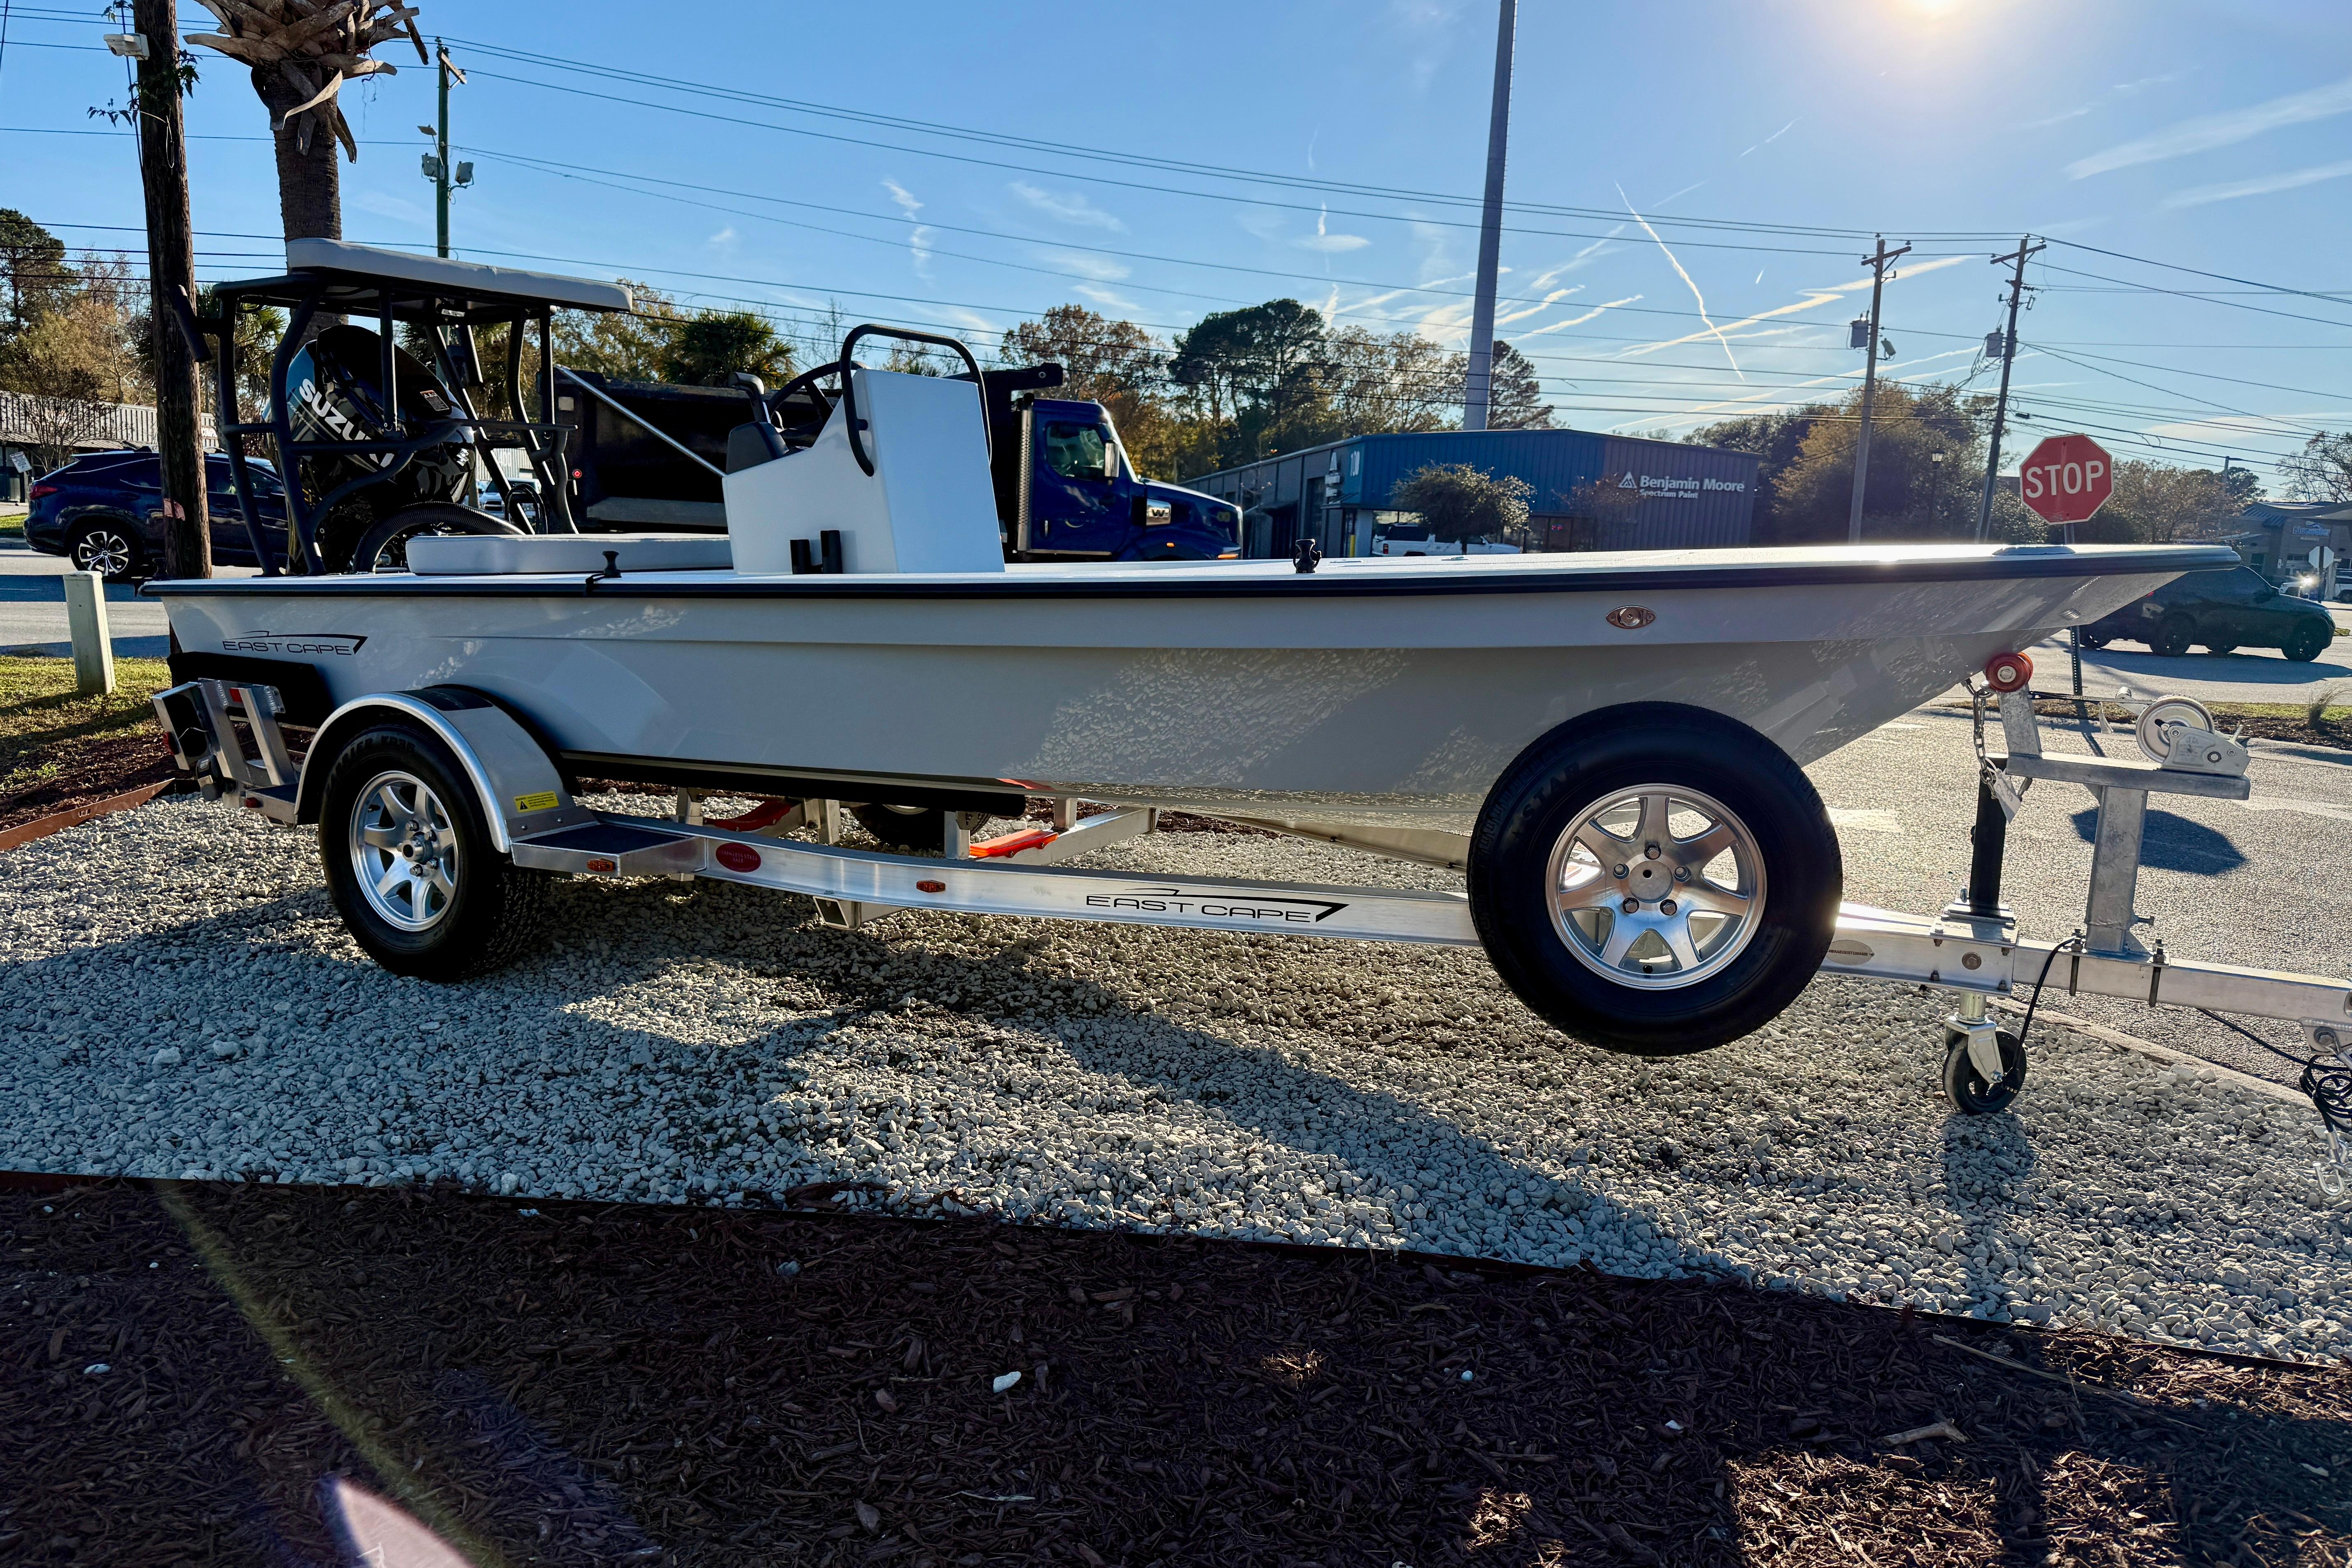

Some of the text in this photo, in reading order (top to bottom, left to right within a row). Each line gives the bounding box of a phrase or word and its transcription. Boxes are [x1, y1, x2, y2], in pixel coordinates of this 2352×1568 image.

[1640, 475, 1745, 492] Benjamin Moore
[2025, 460, 2104, 498] STOP
[1640, 489, 1676, 498] Spectrum
[222, 641, 352, 656] EAST CAPE
[1086, 895, 1310, 923] EAST CAPE
